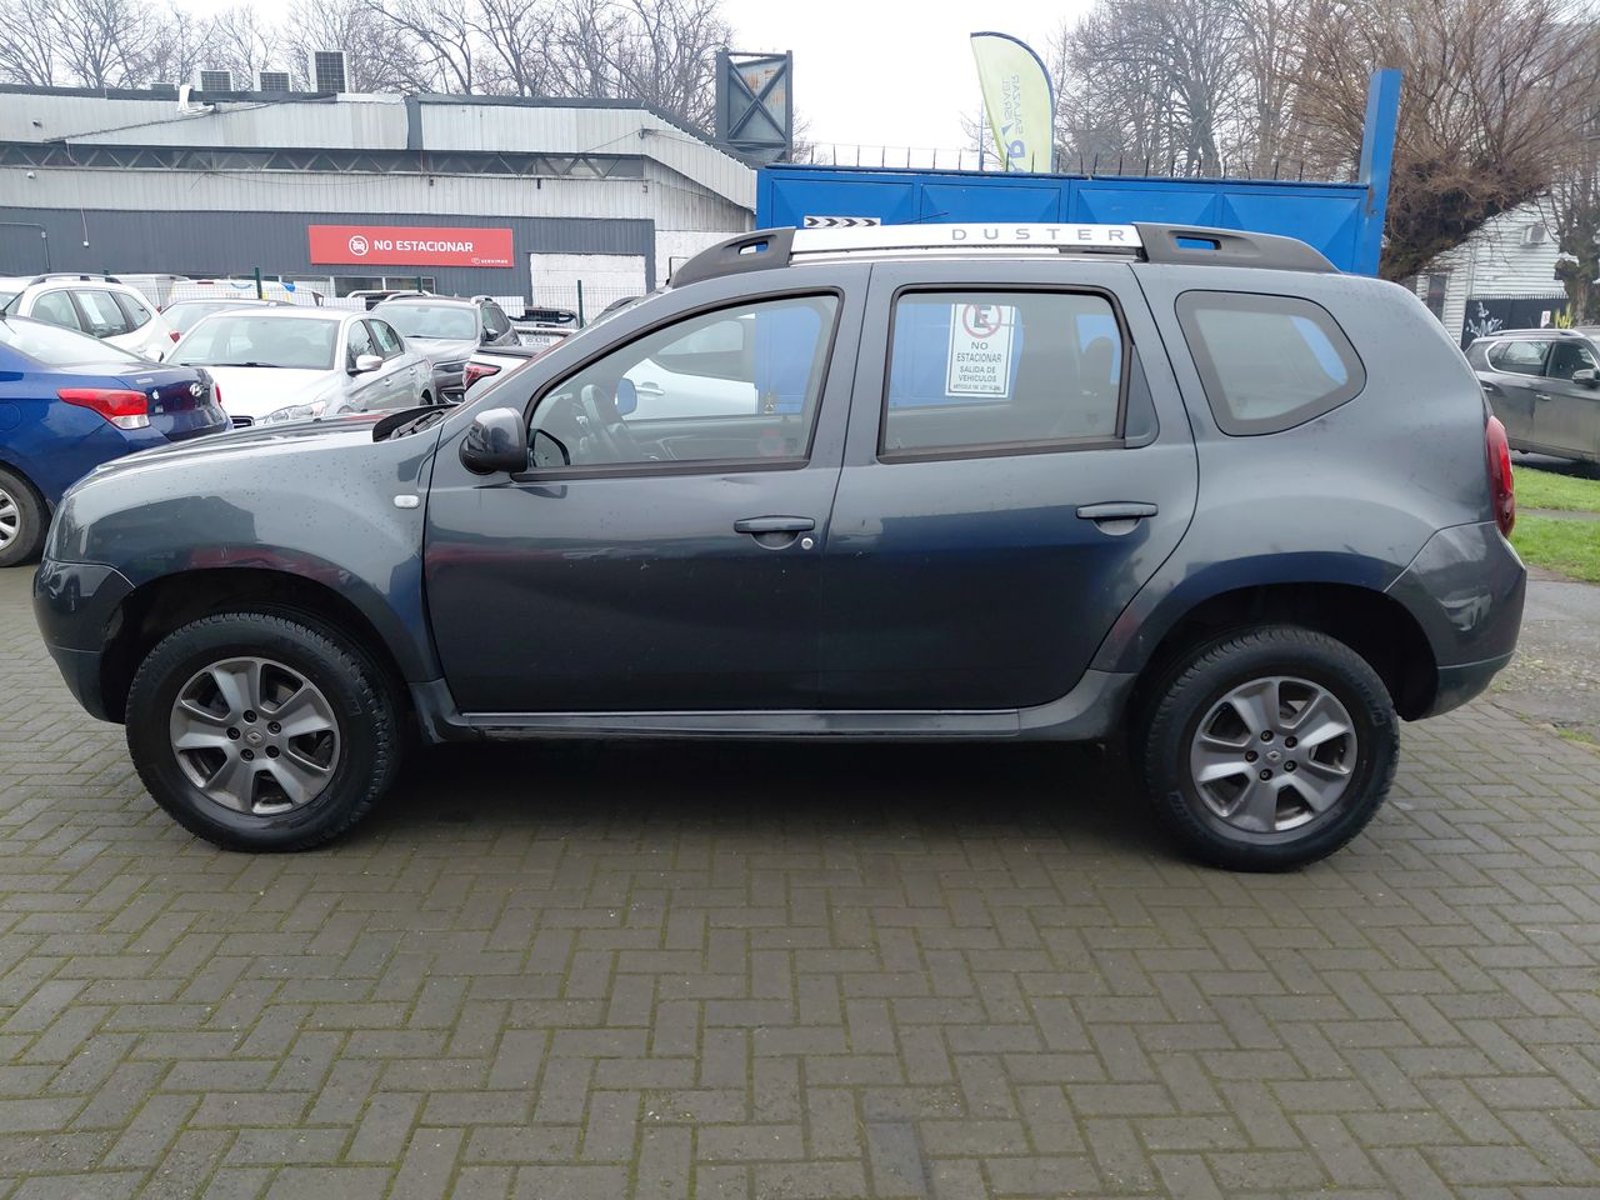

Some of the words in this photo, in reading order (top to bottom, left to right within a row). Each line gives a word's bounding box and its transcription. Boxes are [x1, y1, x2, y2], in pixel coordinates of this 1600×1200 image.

[952, 228, 1125, 241] DUSTER
[374, 240, 393, 250] NO
[396, 241, 473, 252] ESTACIONAR
[971, 341, 989, 350] NO
[956, 352, 1002, 363] ESTACIONAR
[960, 365, 985, 374] SALIDA
[987, 366, 996, 374] DE
